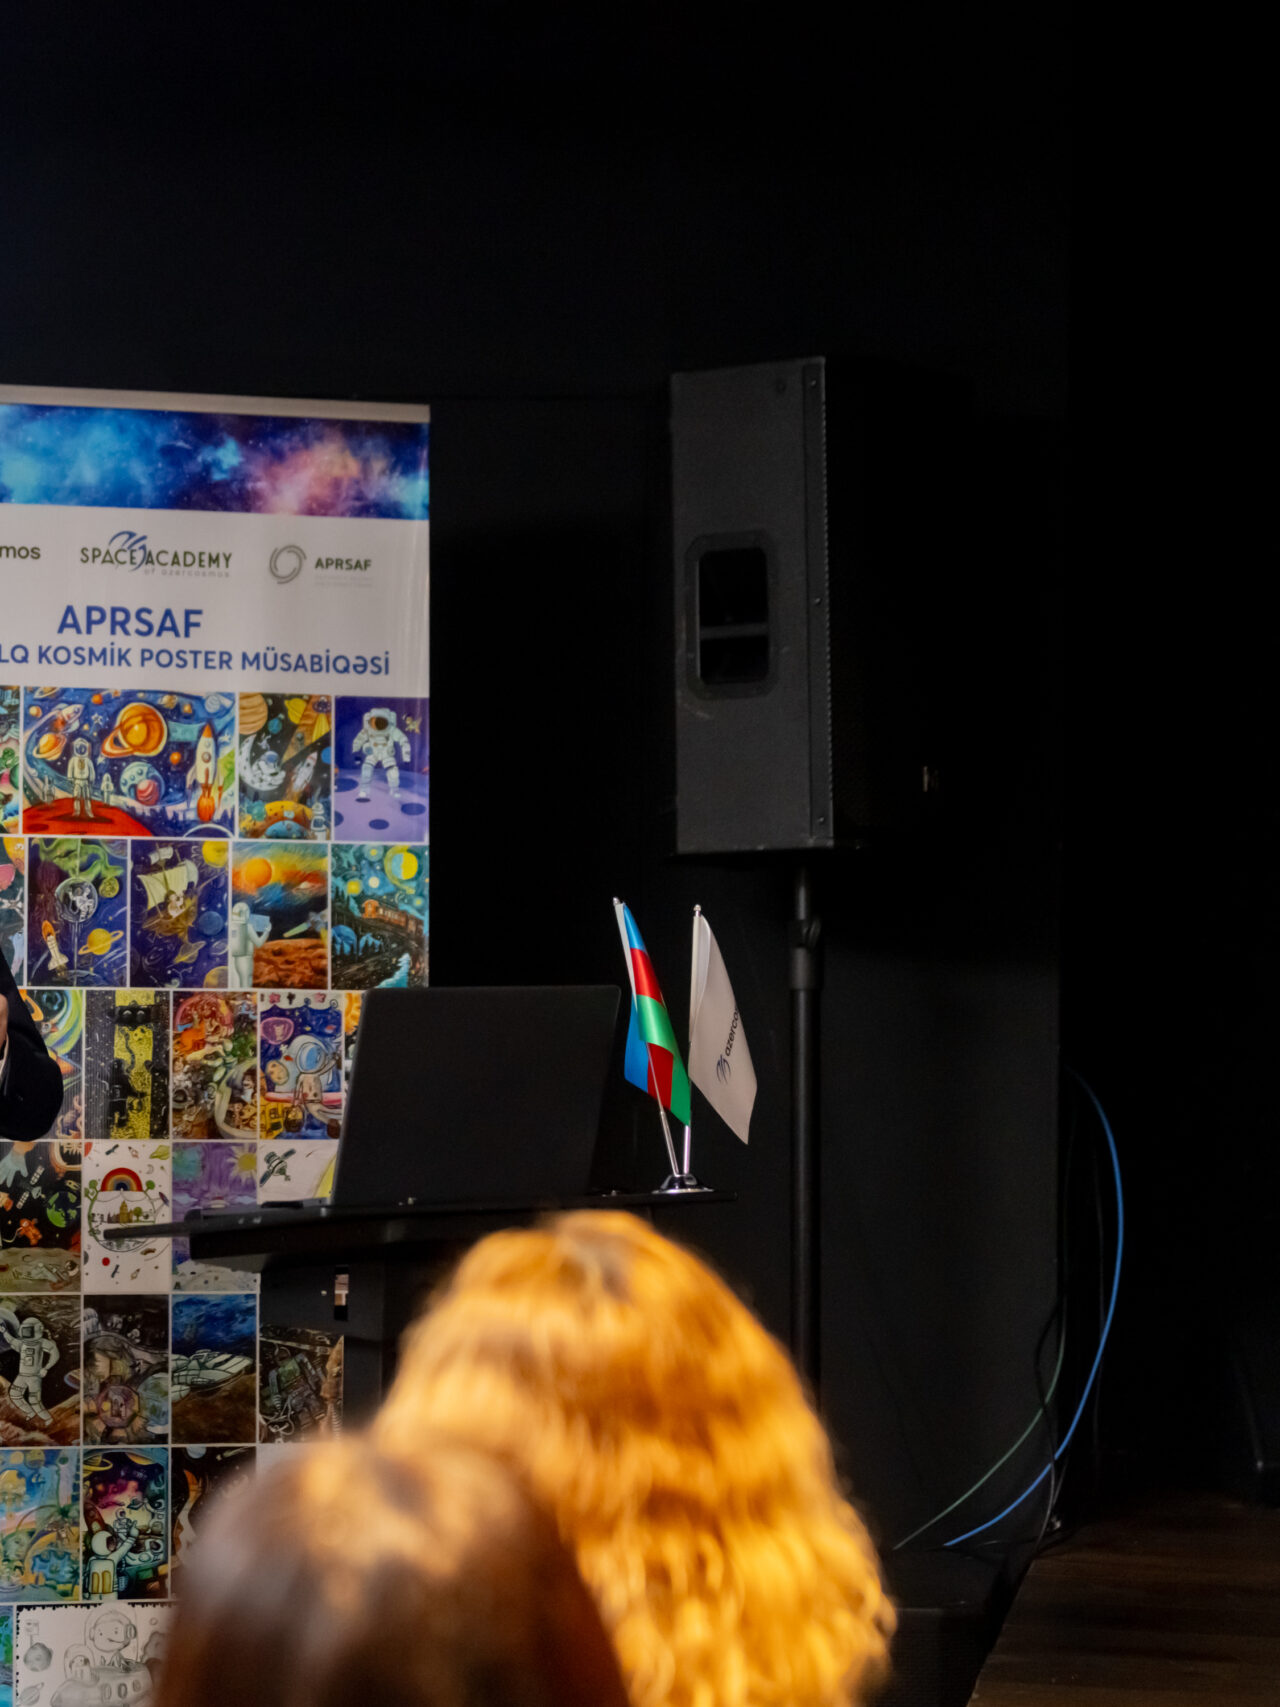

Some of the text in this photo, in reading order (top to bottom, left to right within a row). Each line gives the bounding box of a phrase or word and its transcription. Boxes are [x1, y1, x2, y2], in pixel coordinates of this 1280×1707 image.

[80, 547, 232, 568] SPACE ACADEMY
[314, 557, 372, 571] APRSAF
[57, 605, 204, 638] APRSAF
[38, 641, 132, 668] KOSMİK
[140, 648, 233, 671] POSTER
[240, 646, 390, 676] MÜSABİQƏSİ
